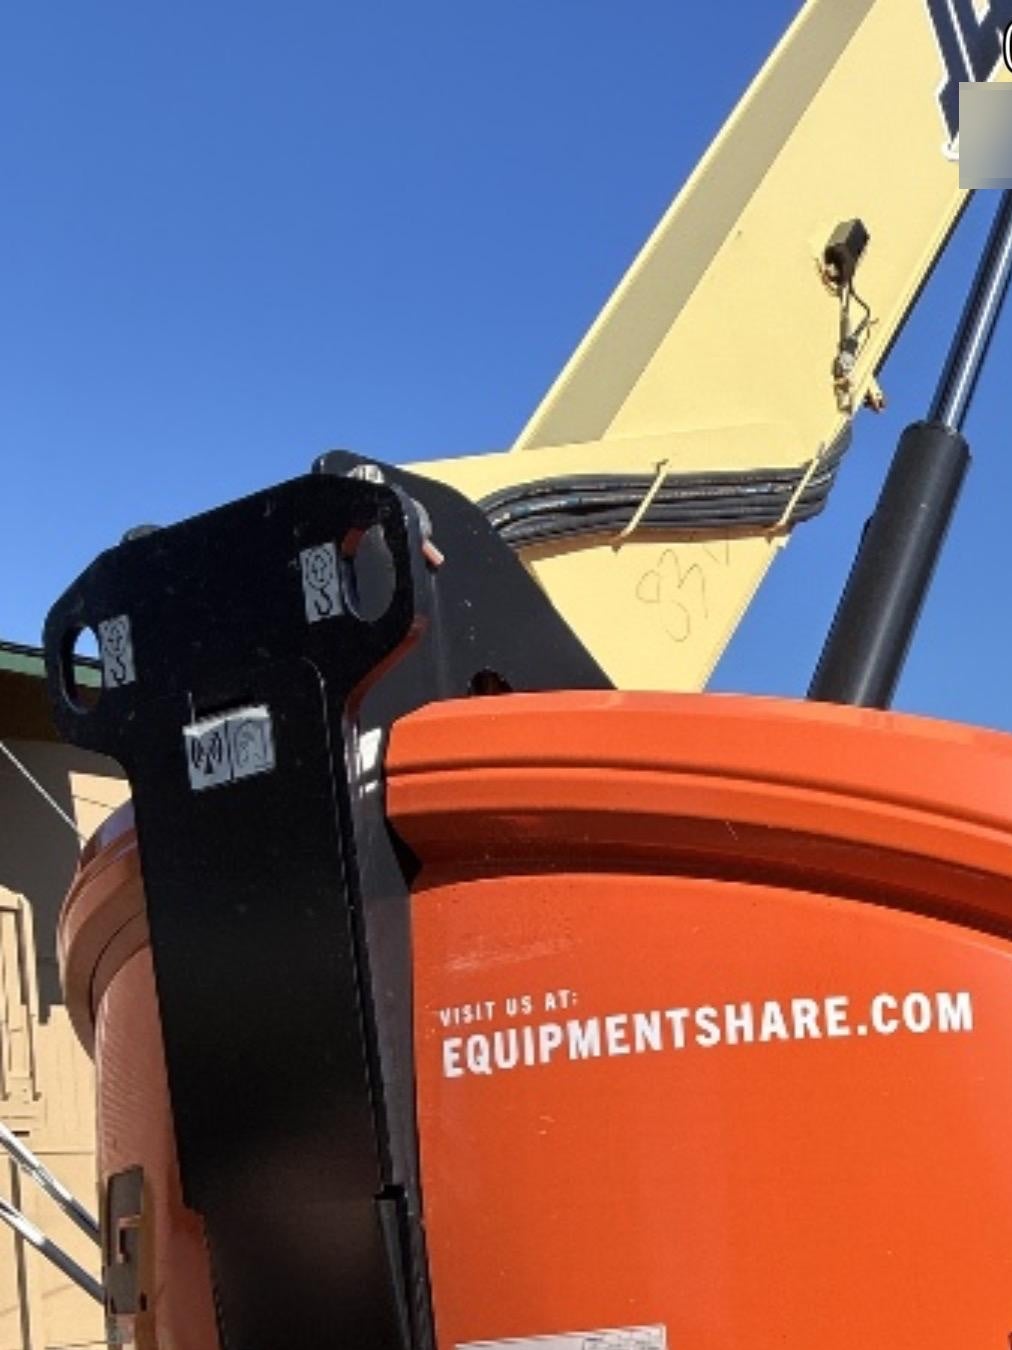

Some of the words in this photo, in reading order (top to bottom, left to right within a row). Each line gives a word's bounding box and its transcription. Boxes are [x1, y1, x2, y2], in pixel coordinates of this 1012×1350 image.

[440, 1001, 495, 1027] VISIT
[506, 995, 532, 1016] US
[545, 989, 578, 1011] AT:
[443, 992, 974, 1078] EQUIPMENTSHARE.COM
